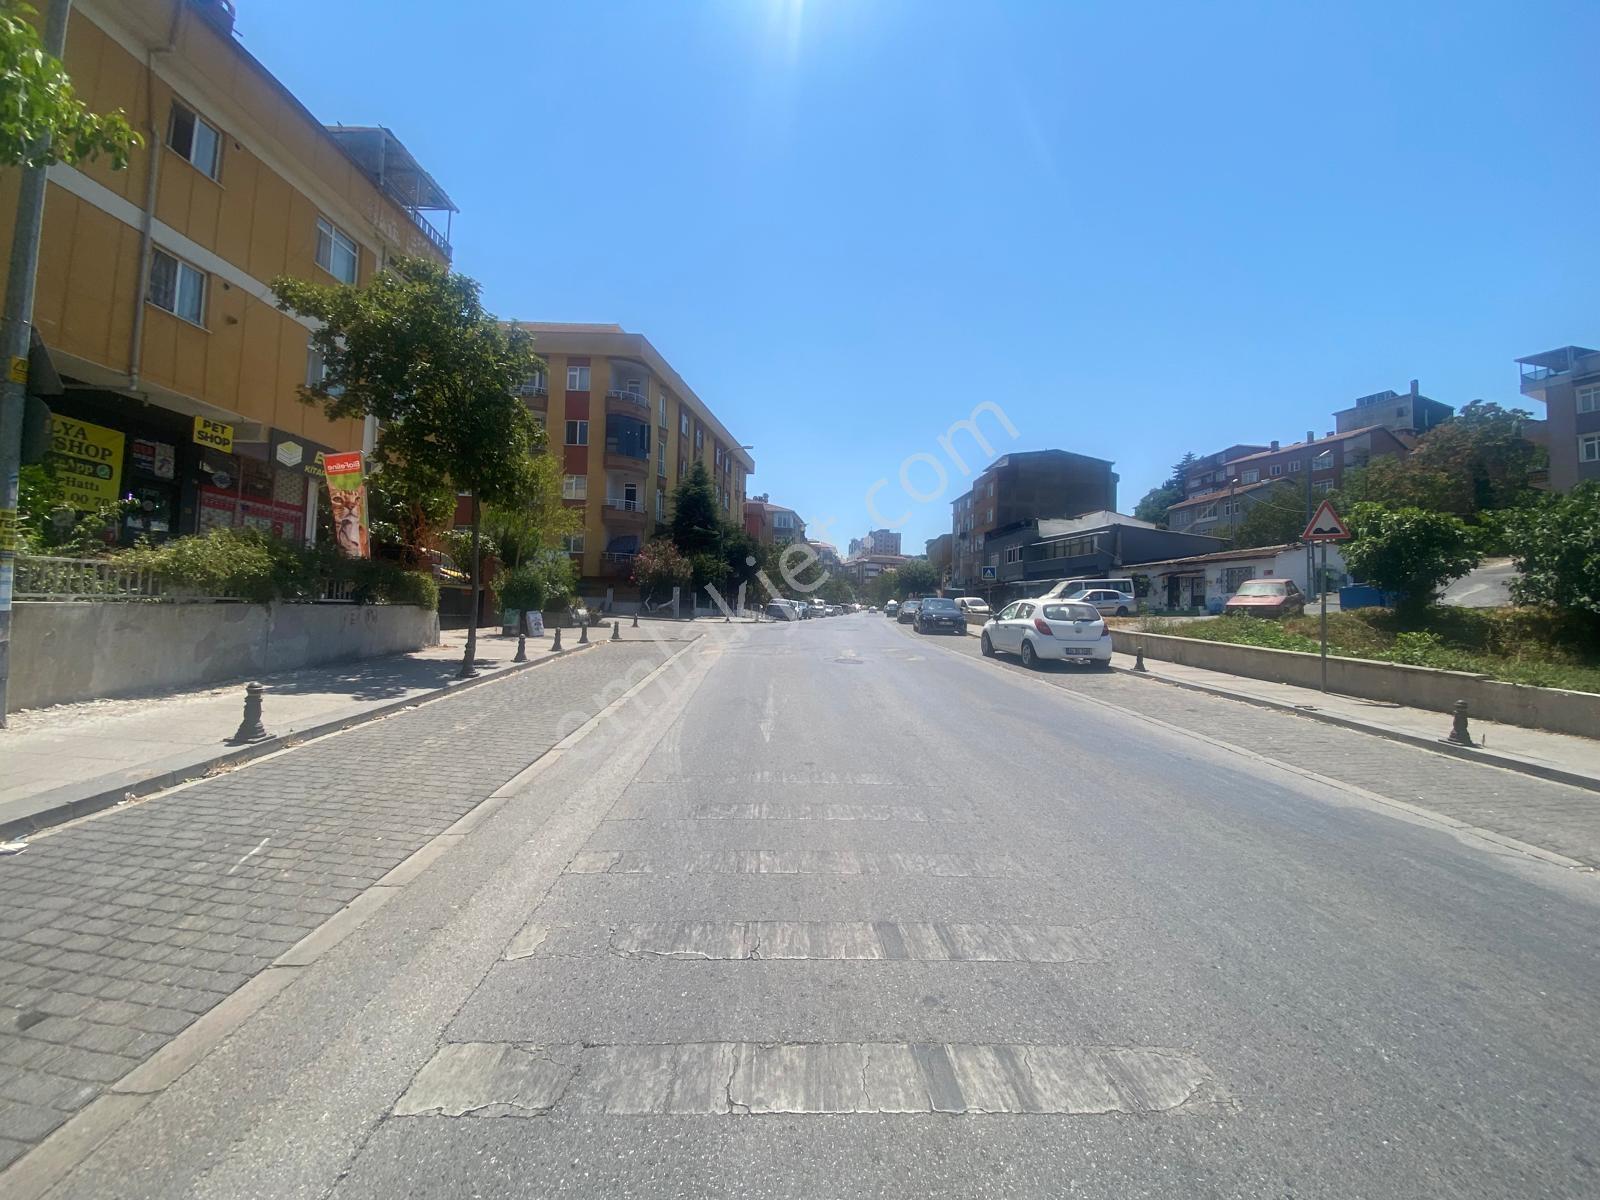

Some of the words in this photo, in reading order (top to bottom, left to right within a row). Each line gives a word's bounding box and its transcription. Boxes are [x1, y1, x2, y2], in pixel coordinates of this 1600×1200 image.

[203, 419, 228, 434] PET
[197, 430, 230, 446] SHOP
[54, 436, 113, 461] SHOP
